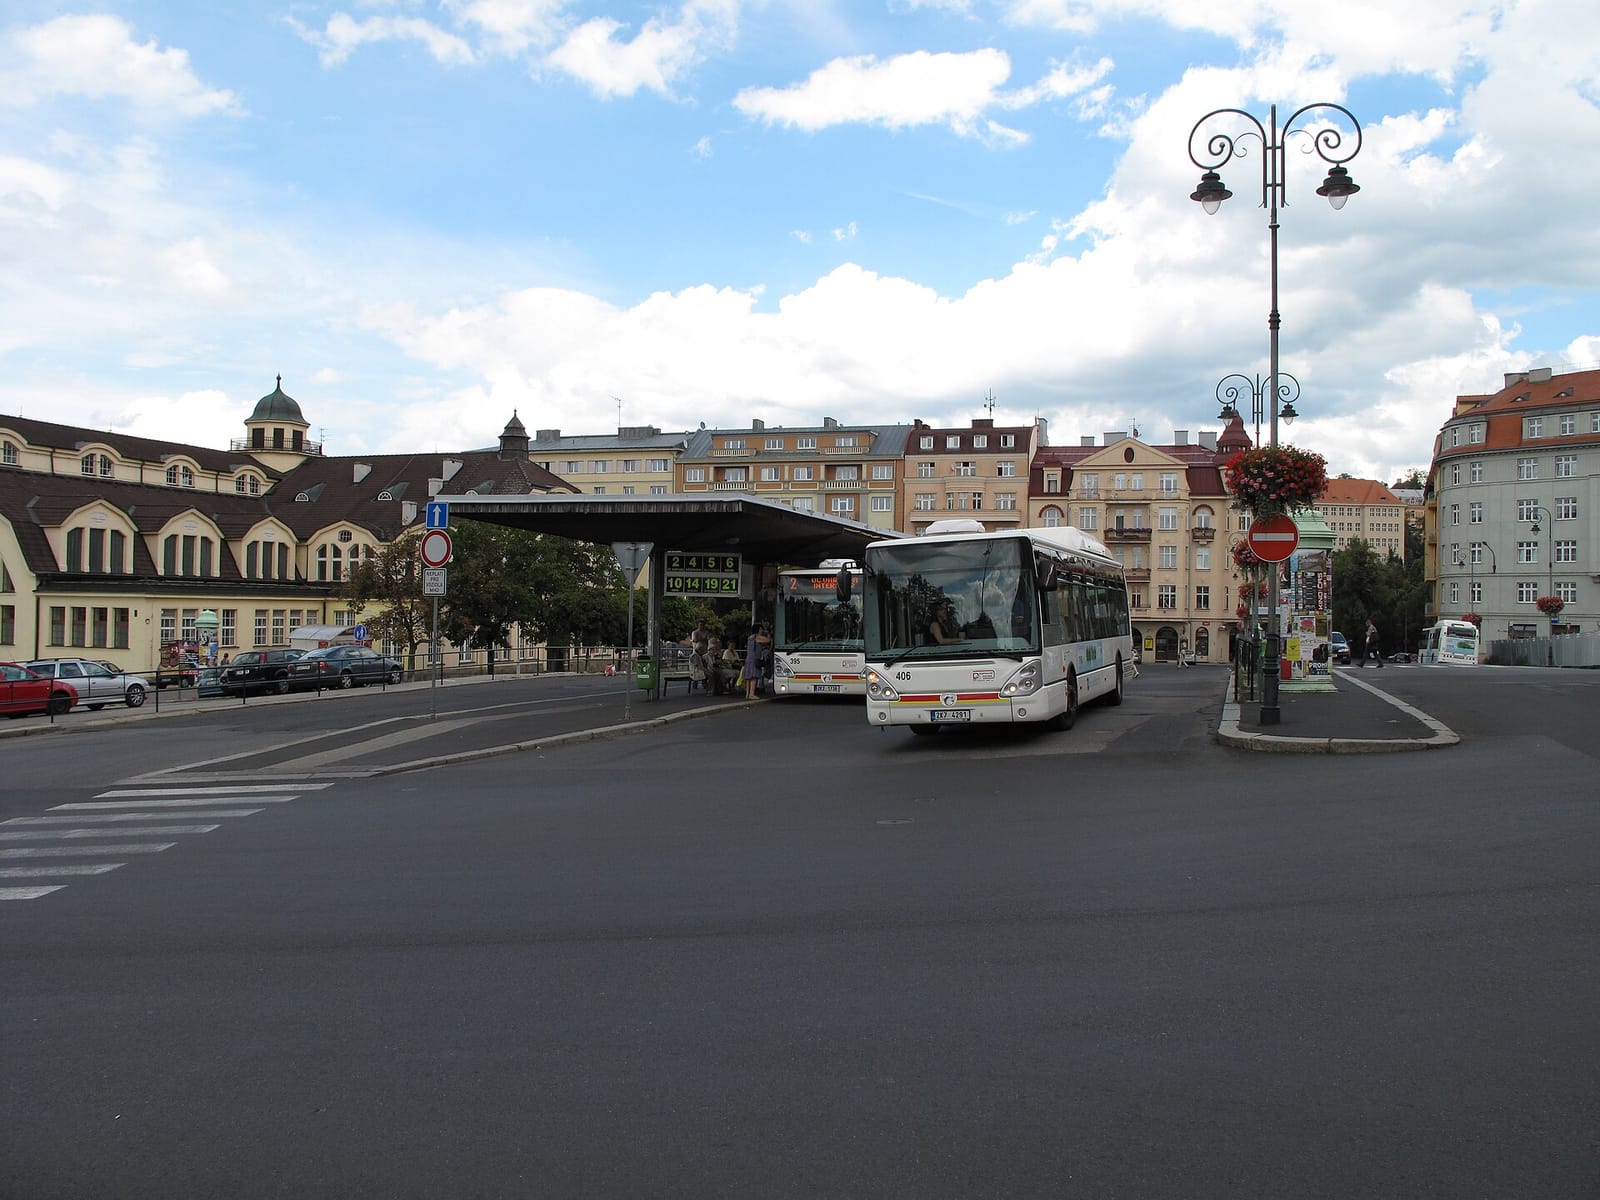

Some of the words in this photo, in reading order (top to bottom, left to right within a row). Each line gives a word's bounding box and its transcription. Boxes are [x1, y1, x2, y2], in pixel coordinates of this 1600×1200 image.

[671, 556, 680, 567] 2
[688, 556, 697, 568] 4
[707, 557, 716, 568] 5
[725, 557, 734, 568] 6
[667, 577, 683, 589] 10
[686, 578, 700, 589] 14
[704, 578, 719, 590] 19
[722, 578, 737, 590] 21
[789, 577, 797, 590] 2
[896, 672, 912, 680] 406
